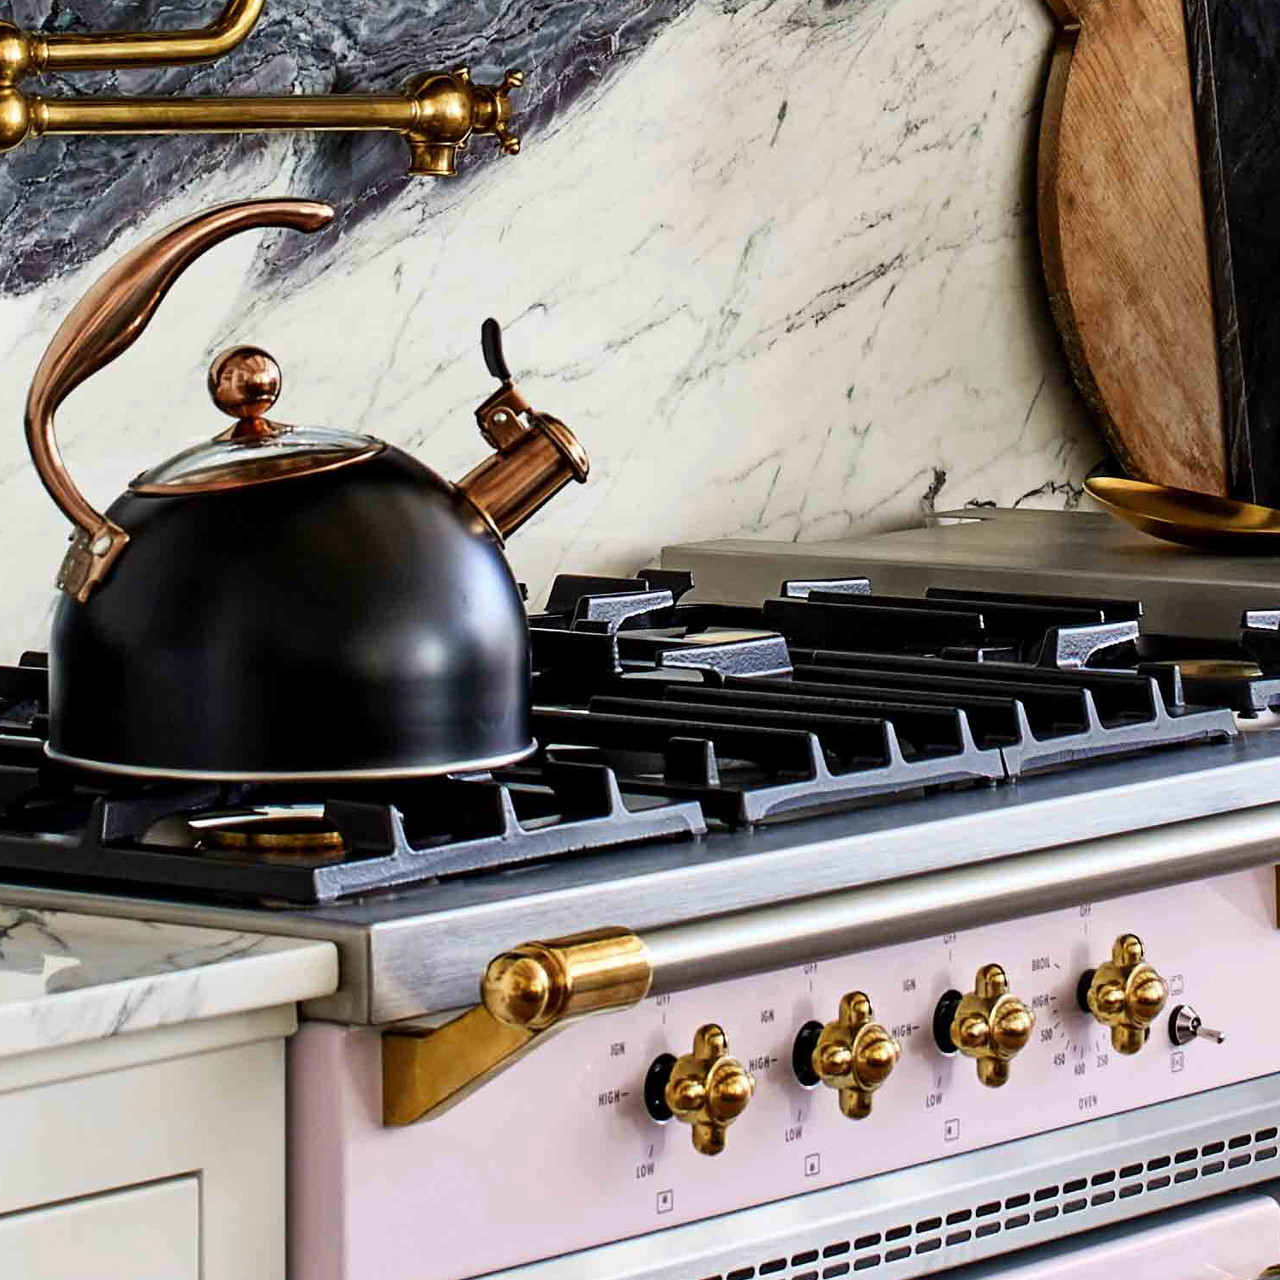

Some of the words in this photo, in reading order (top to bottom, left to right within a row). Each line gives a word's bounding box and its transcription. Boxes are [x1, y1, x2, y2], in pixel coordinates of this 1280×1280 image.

[903, 979, 916, 992] IGN
[1032, 995, 1048, 1010] HIGH
[761, 1009, 774, 1023] IGN
[890, 1024, 911, 1040] HIGH
[1041, 1028, 1054, 1042] 500
[611, 1042, 625, 1056] IGN
[749, 1056, 769, 1072] HIGH
[1053, 1053, 1065, 1066] 450
[599, 1090, 620, 1106] HIGH
[926, 1093, 942, 1108] LOW
[1079, 1095, 1097, 1110] OVEN
[785, 1127, 802, 1142] LOW
[636, 1163, 654, 1179] LOW
